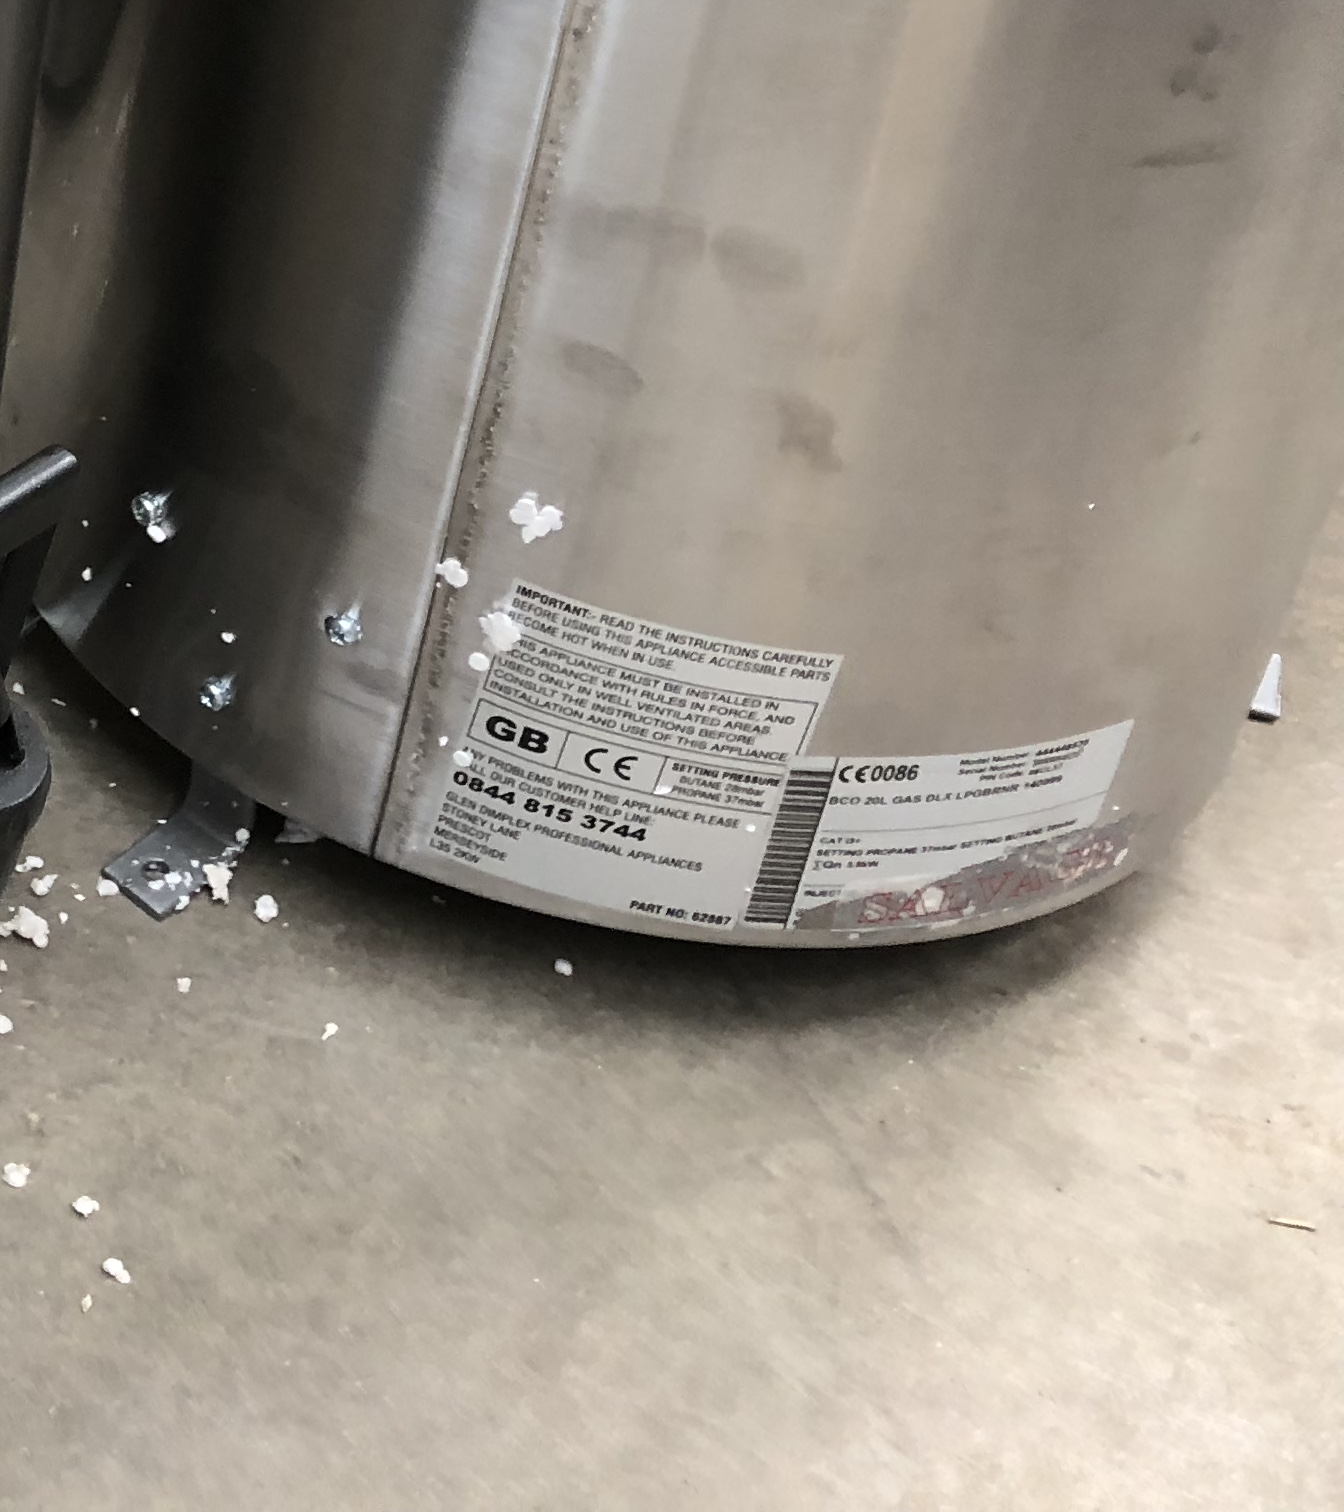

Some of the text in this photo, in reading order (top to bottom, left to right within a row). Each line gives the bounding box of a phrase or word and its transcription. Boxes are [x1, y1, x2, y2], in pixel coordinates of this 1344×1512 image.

[512, 597, 831, 682] BEFORE USING THIS APPLIANCE ACCESSIBLE PARTS
[562, 631, 589, 646] HOT
[591, 640, 629, 660] WHEN
[631, 651, 644, 663] IN
[600, 614, 635, 632] READ
[639, 624, 662, 639] THE
[665, 632, 759, 659] INSTRUCTIONS
[762, 650, 834, 668] CAREFULLY
[498, 657, 536, 678] USED
[538, 672, 575, 691] ONLY
[577, 685, 592, 697] IN
[595, 690, 632, 708] WELL
[637, 701, 721, 727] VENTILATED
[515, 639, 780, 711] HIS APPLIANCE MUST BE INSTALLED IN
[602, 679, 638, 698] WITH
[640, 690, 687, 708] RULES
[690, 701, 705, 712] IN
[764, 714, 796, 725] AND
[489, 680, 789, 762] INSTALLATION AND USE OF THIS APPLIANCE
[494, 668, 757, 746] CONSULT THE INSTRUCTIONS BEFORE
[485, 715, 550, 754] GB
[488, 756, 553, 787] PROBLEMS
[557, 779, 589, 796] WITH
[593, 790, 619, 806] THIS
[622, 799, 690, 821] APPLIANCE
[693, 813, 741, 829] PLEASE
[490, 771, 516, 787] OUR
[518, 781, 586, 809] CUSTOMER
[589, 802, 622, 817] HELP
[672, 762, 719, 778] SETTING
[442, 802, 521, 841] STONEY LANE
[453, 771, 647, 841] 0844 815 3744
[892, 794, 921, 804] GAS
[445, 790, 703, 873] GLEN DIMPLEX PROFESSIONAL APPLIANCES
[629, 900, 663, 915] PART
